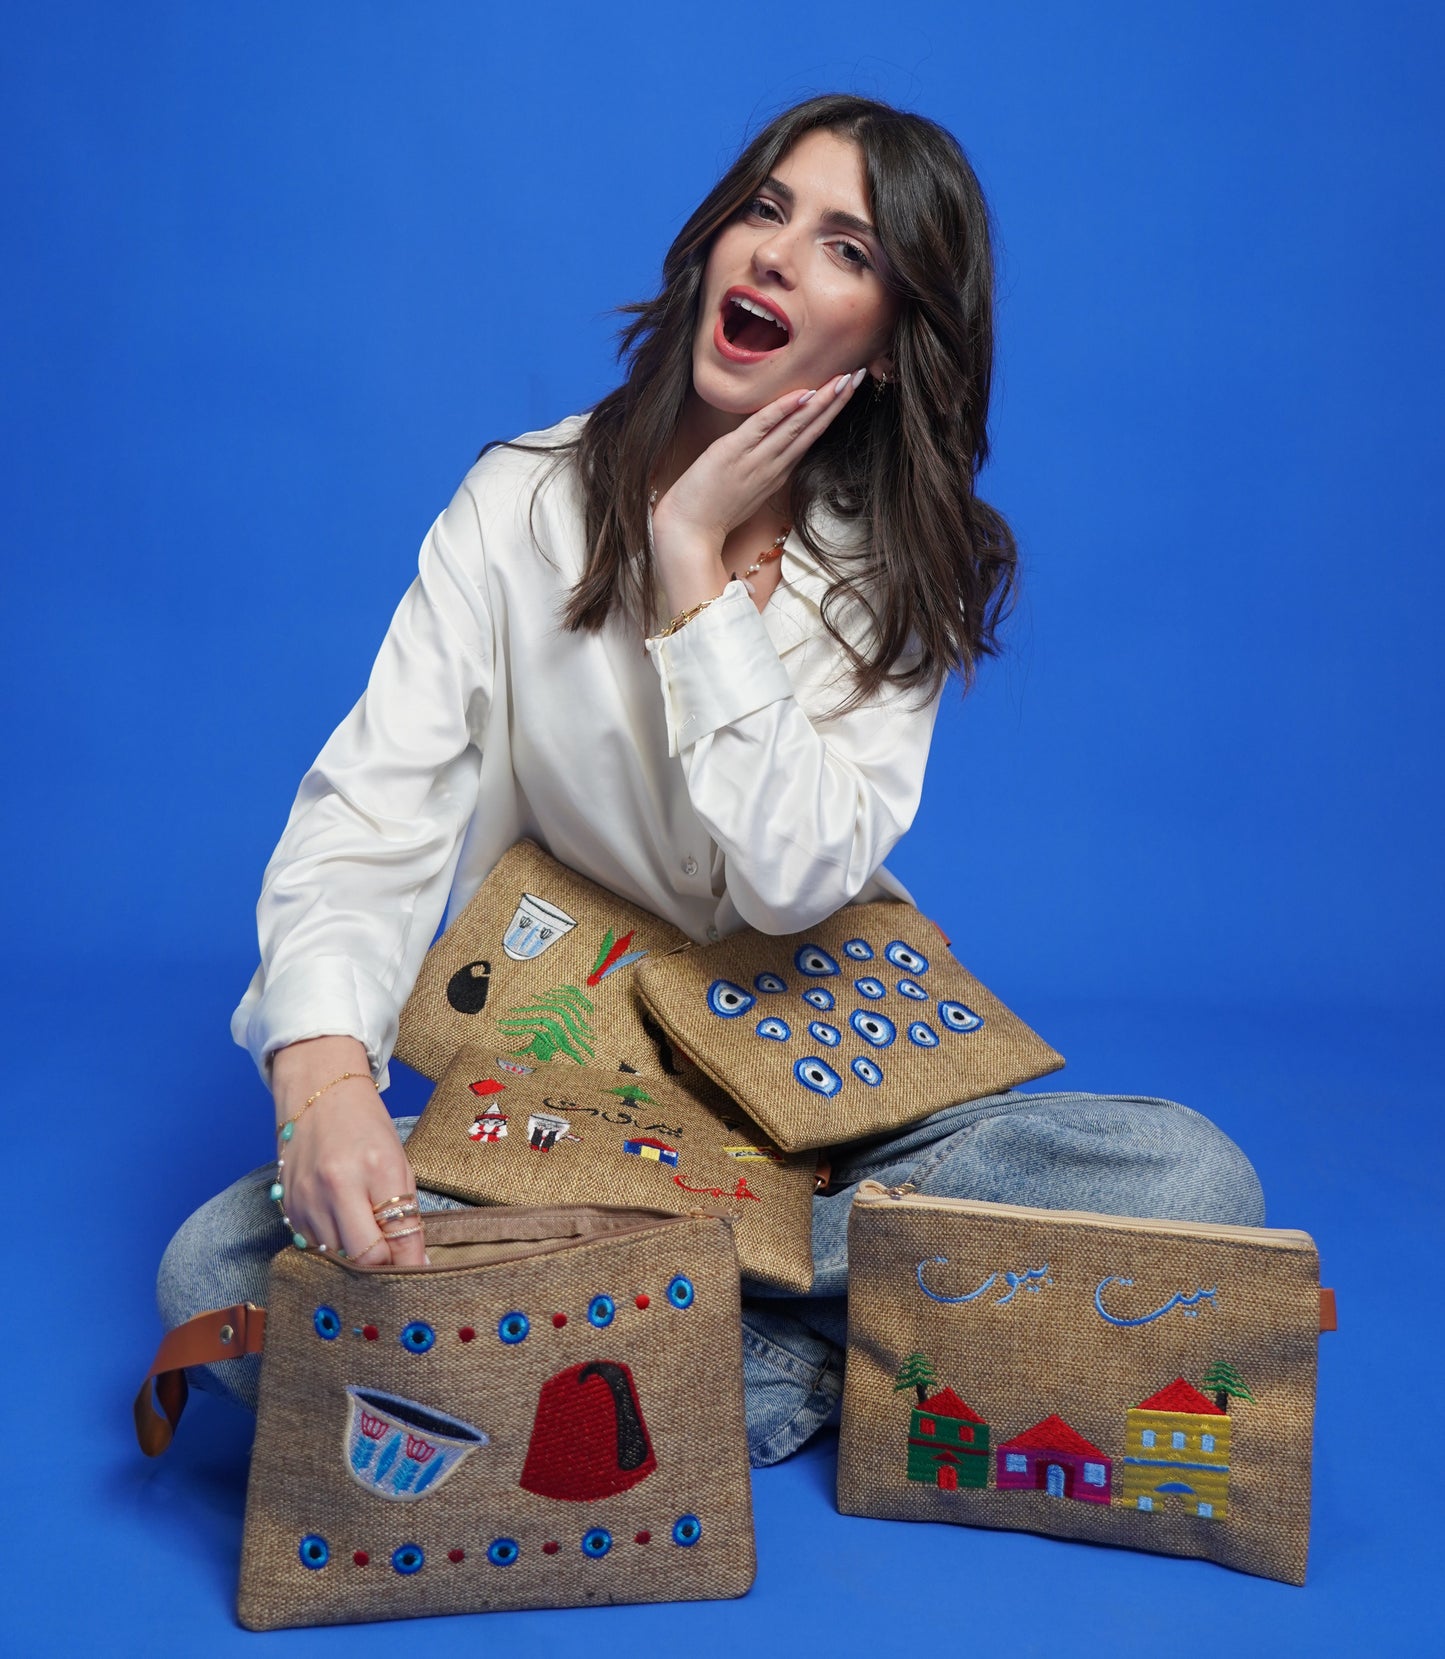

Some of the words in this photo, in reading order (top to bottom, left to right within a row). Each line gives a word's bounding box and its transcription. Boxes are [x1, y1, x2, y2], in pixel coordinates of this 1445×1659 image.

[542, 1096, 684, 1139] بيروت
[917, 1255, 1054, 1304] بيوت
[1094, 1275, 1219, 1327] بيت
